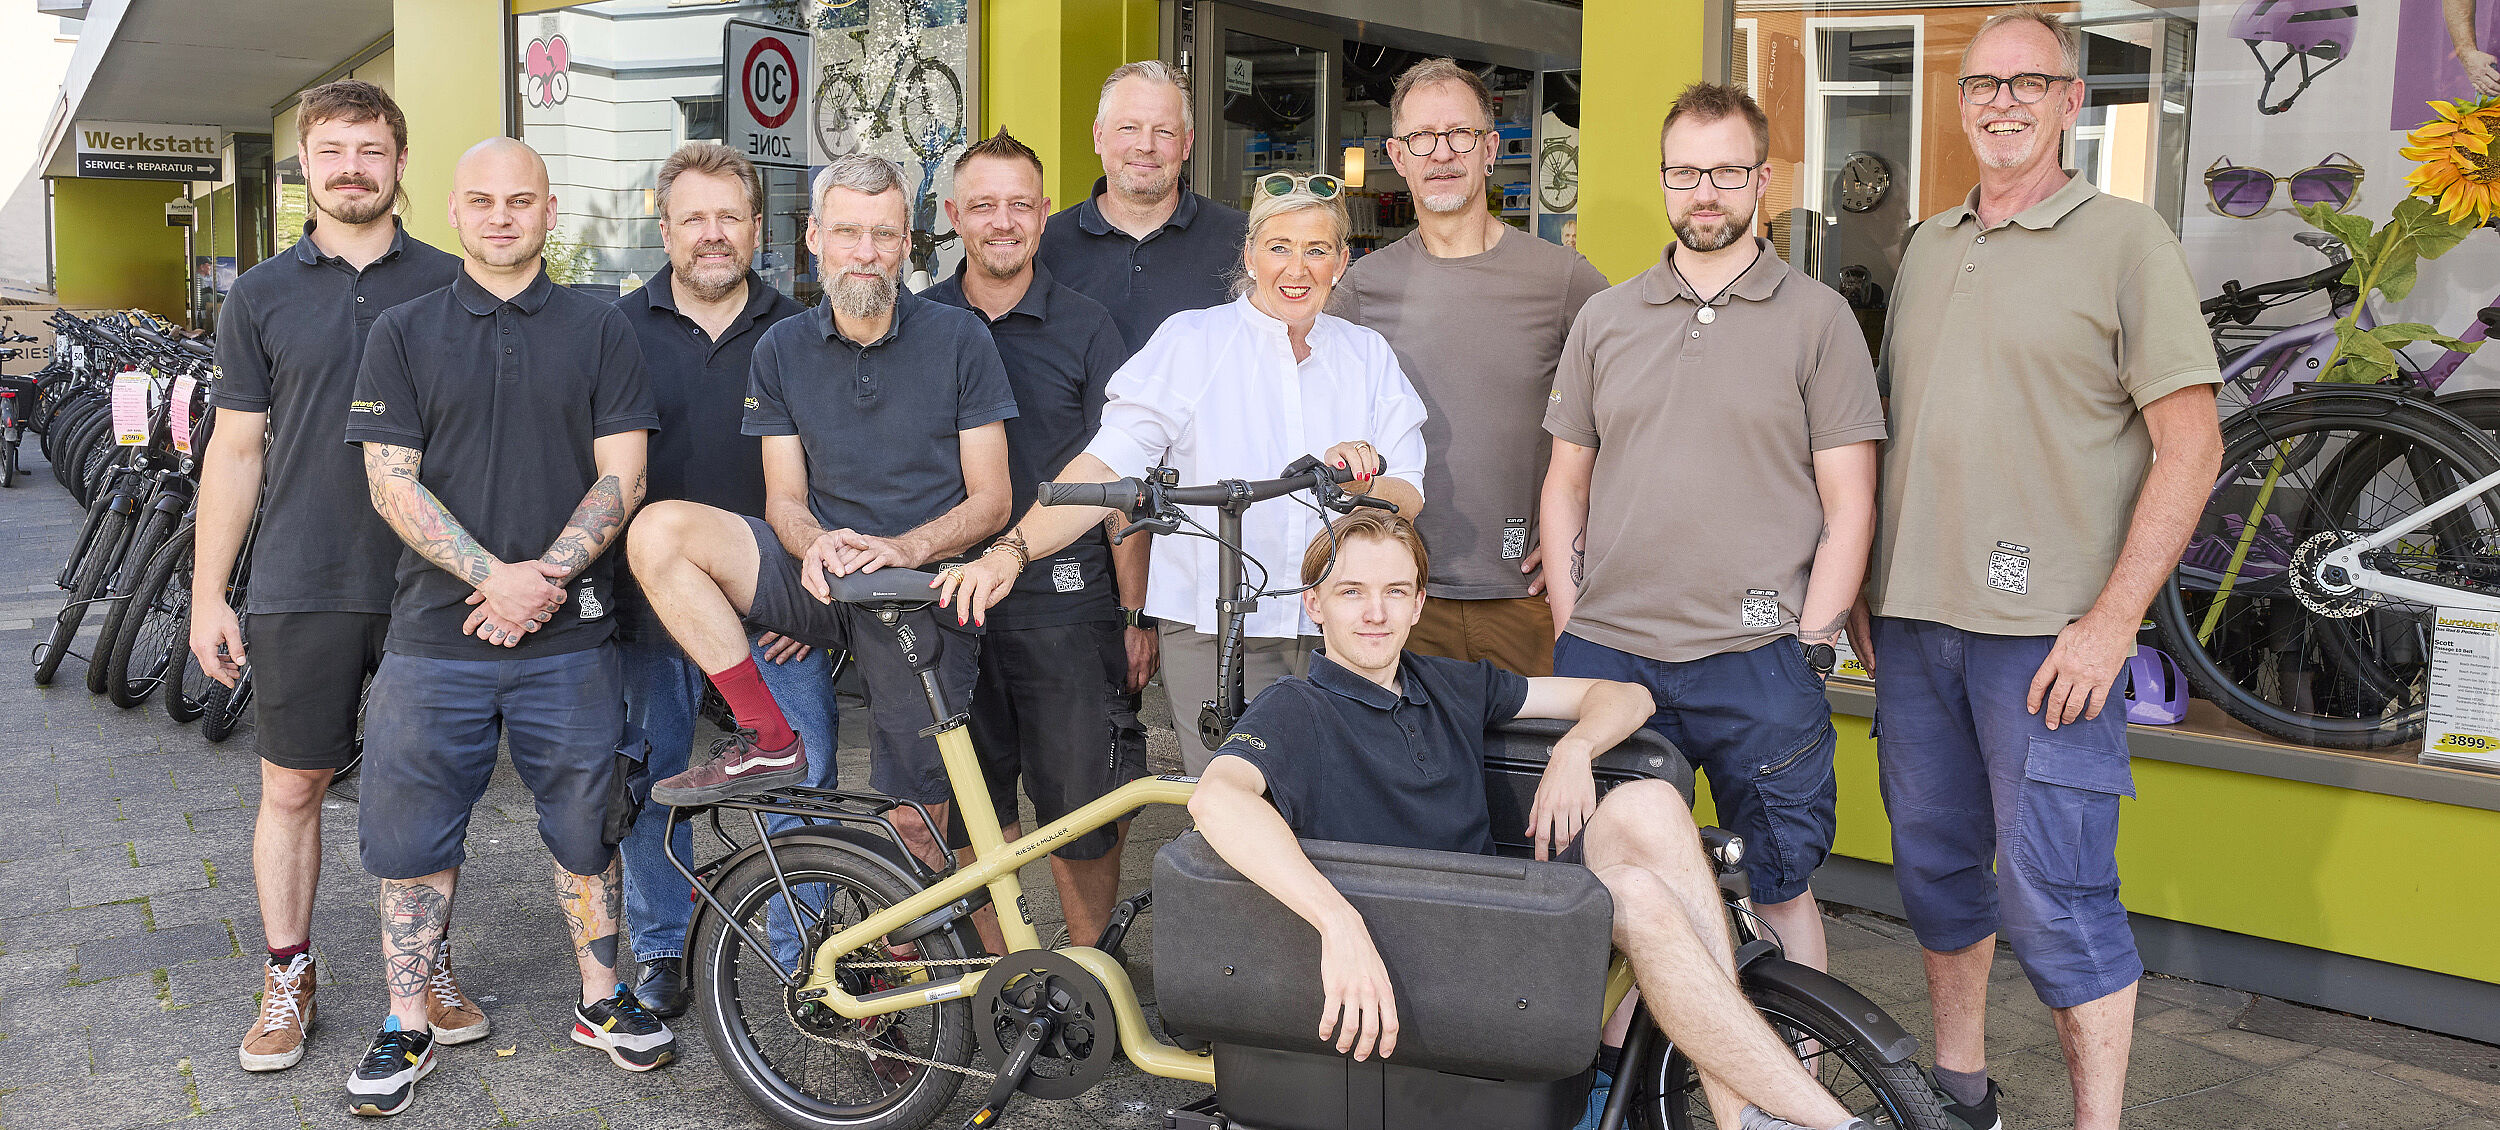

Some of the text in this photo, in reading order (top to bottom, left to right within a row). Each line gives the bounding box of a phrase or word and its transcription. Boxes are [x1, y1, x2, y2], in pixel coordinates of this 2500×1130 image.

[84, 131, 215, 154] Werkstatt
[85, 160, 126, 170] SERVICE
[137, 163, 194, 172] REPARATUR
[74, 352, 82, 360] 50
[2449, 734, 2496, 749] 3899.-
